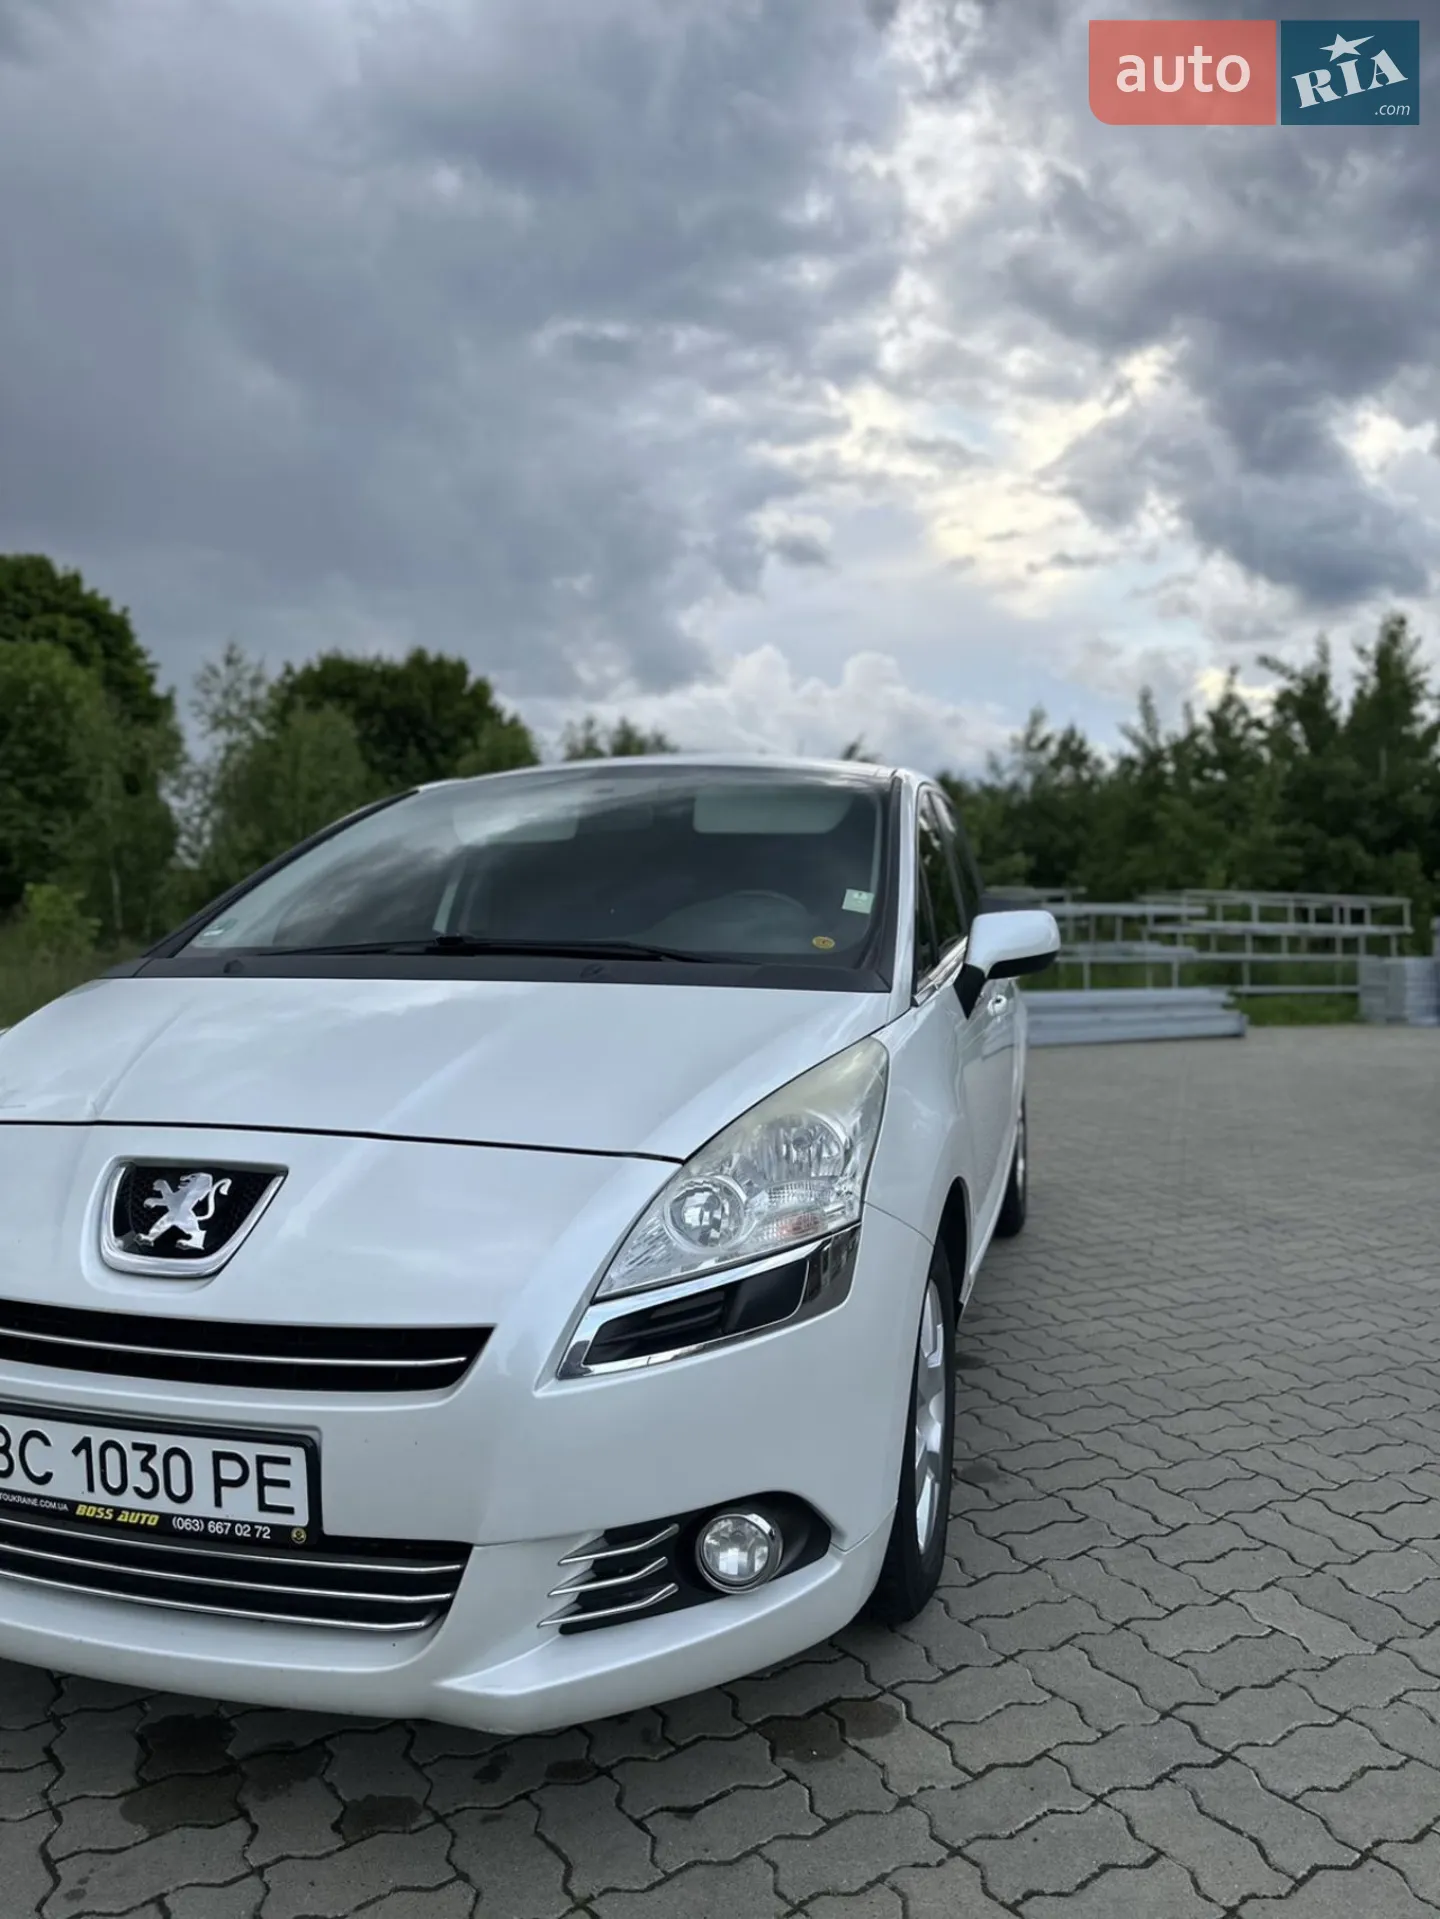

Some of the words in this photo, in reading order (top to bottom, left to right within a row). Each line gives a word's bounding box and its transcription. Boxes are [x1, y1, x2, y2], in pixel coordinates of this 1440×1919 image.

[71, 1436, 195, 1504] 1030
[212, 1449, 295, 1514] PE
[75, 1504, 114, 1520] BOSS
[116, 1510, 160, 1526] AUTO
[172, 1516, 205, 1532] (063)
[207, 1520, 232, 1535] 667
[234, 1523, 251, 1537] 02
[254, 1525, 271, 1539] 72
